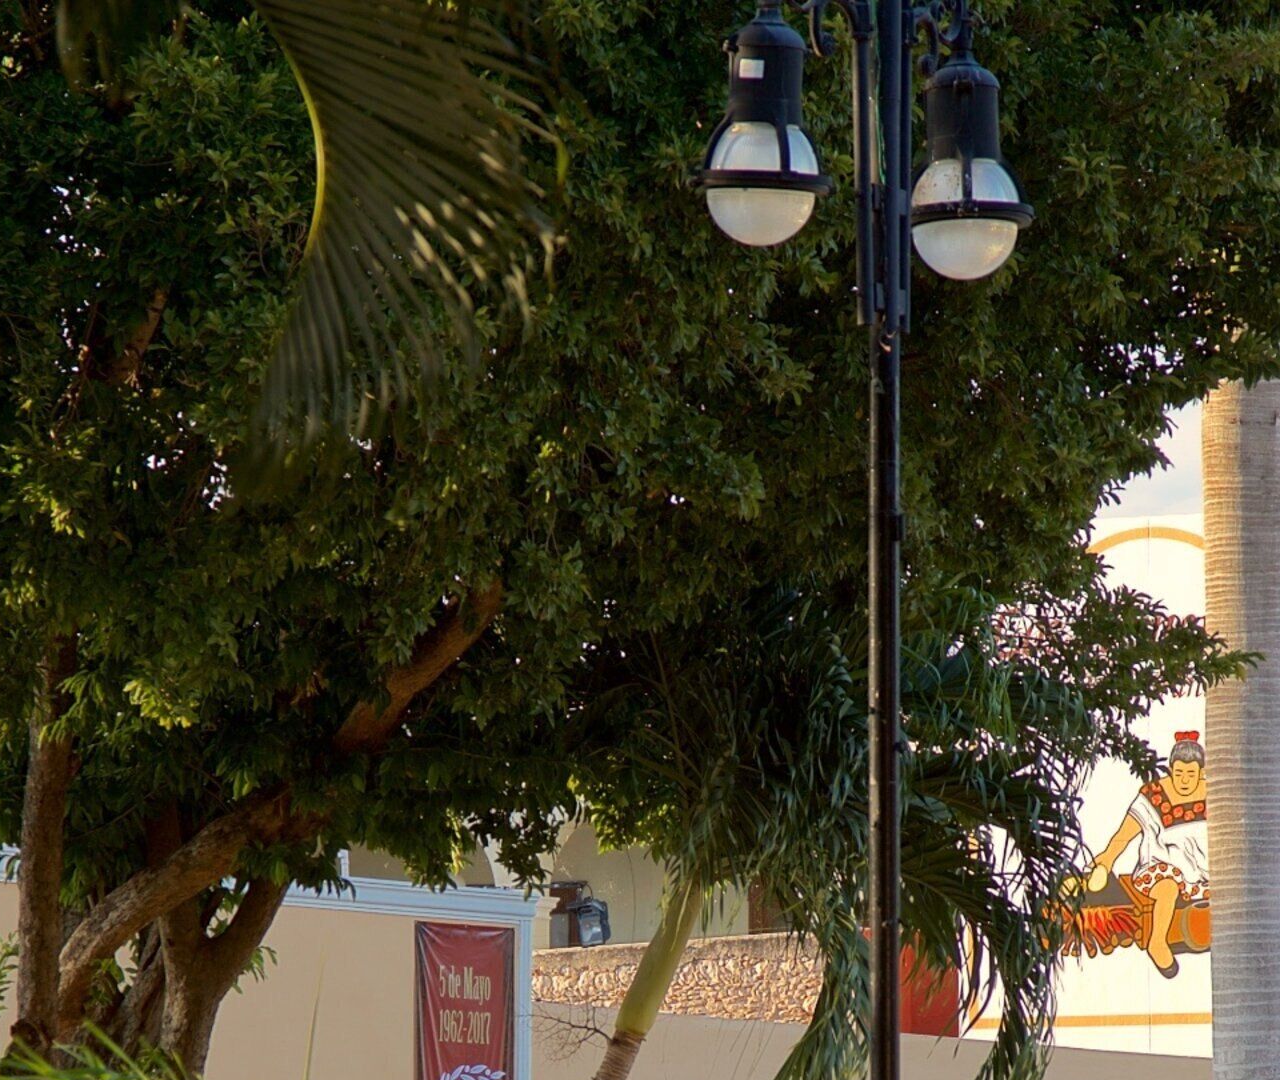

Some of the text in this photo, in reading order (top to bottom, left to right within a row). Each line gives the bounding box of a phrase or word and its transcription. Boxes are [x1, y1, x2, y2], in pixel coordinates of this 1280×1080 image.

[439, 964, 491, 1006] 5 de Mayo
[439, 1008, 492, 1045] 1962-2017
